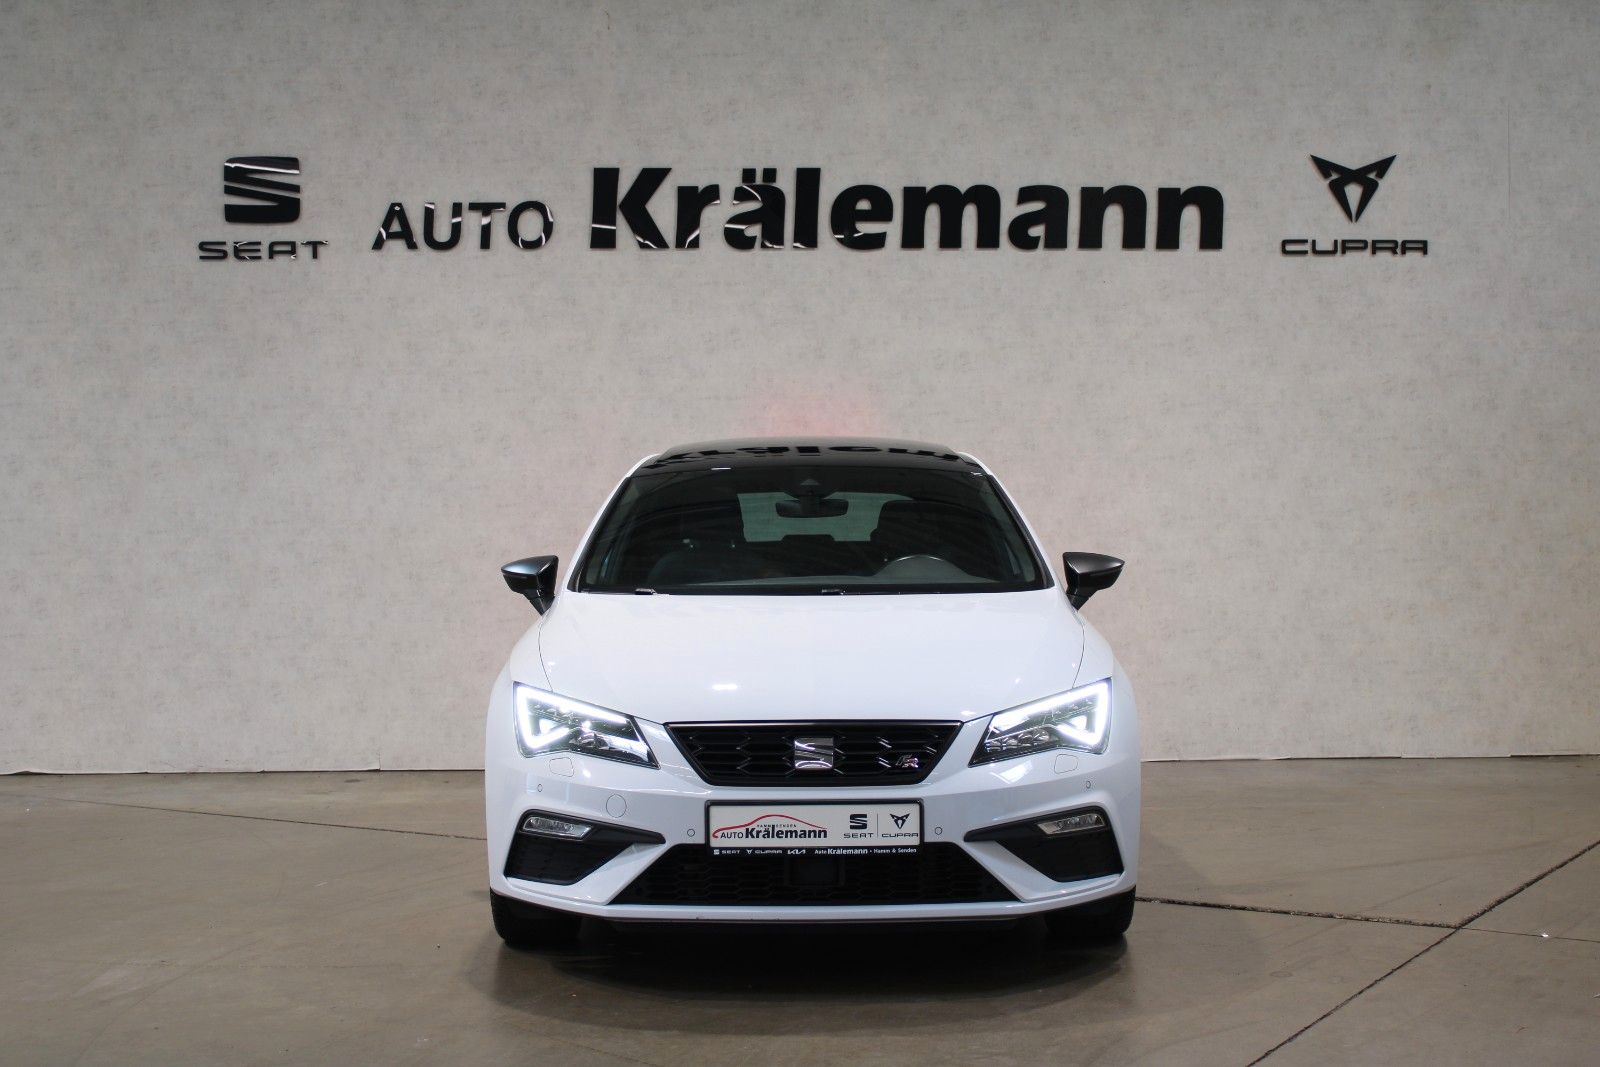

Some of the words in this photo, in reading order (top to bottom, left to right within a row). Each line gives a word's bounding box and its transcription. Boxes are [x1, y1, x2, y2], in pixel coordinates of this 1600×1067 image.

[371, 200, 554, 252] AUTO
[590, 167, 1224, 251] Krälemann
[198, 240, 329, 261] SEAT
[1281, 238, 1429, 257] CUPRA
[720, 831, 744, 839] AUTO
[744, 824, 828, 839] Krälemann
[827, 847, 868, 855] Krälemann
